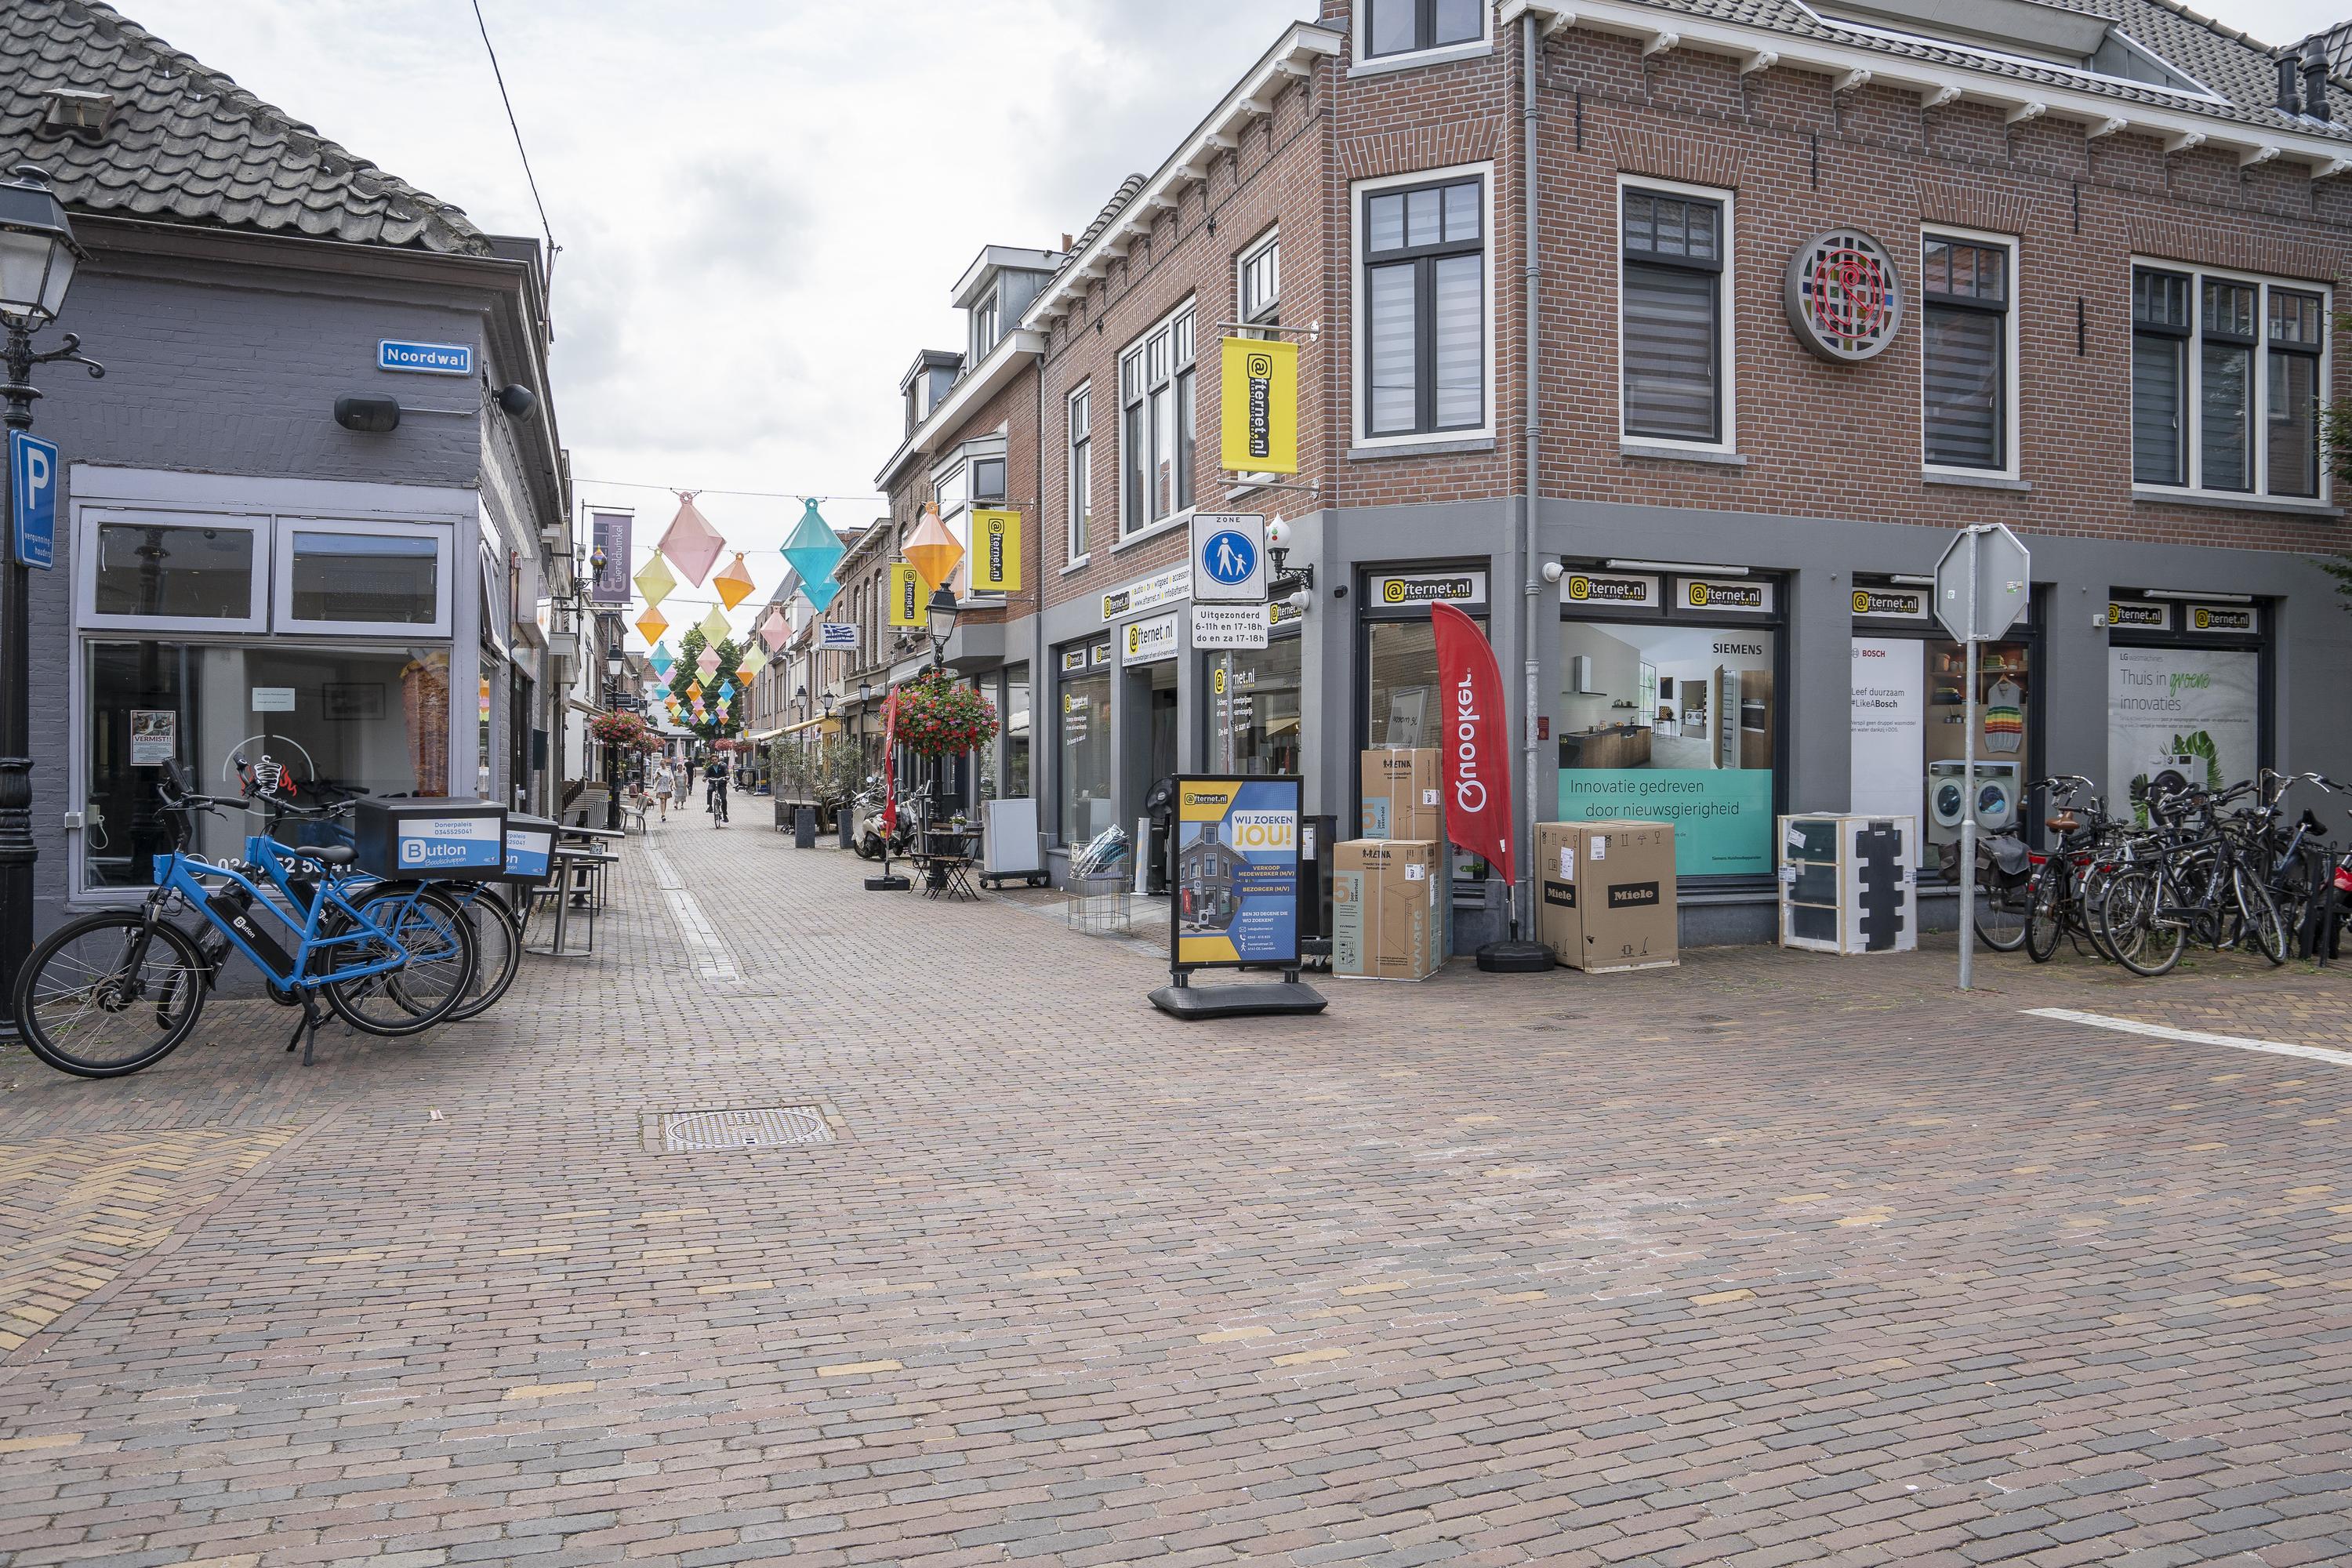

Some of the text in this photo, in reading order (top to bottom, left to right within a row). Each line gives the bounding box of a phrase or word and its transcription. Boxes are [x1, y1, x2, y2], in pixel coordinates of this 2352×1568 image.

[387, 348, 464, 366] Noordwal
[1251, 358, 1268, 454] @fternet.nl
[27, 447, 49, 510] P
[24, 532, 53, 548] vergunning-
[34, 547, 51, 558] houders
[612, 525, 623, 583] wereldwinkel
[1387, 581, 1469, 599] @fternet.nl
[1572, 579, 1645, 596] @fternet.nl
[1692, 586, 1759, 602] @fternet.nl
[1855, 594, 1917, 609] @fternet.nl
[1200, 612, 1260, 620] Uitgezonderd
[2197, 612, 2248, 626] @fternet.nl
[1130, 619, 1173, 652] @fternet.nl
[1712, 643, 1762, 655] SIEMENS
[2120, 669, 2210, 697] Thuis in groene
[1851, 687, 1905, 696] Leef duurzaam
[1851, 699, 1898, 708] #LikeABosch
[2120, 695, 2182, 711] innovaties
[1570, 779, 1704, 796] Innovatie gedreven
[1185, 794, 1227, 804] @fternet.nl
[1585, 801, 1740, 818] door nieuwsgierigheid
[1235, 825, 1291, 846] JOU!
[405, 842, 466, 859] Butlon
[1548, 887, 1572, 901] Miele
[1614, 889, 1653, 901] Miele
[234, 916, 256, 938] Butlon
